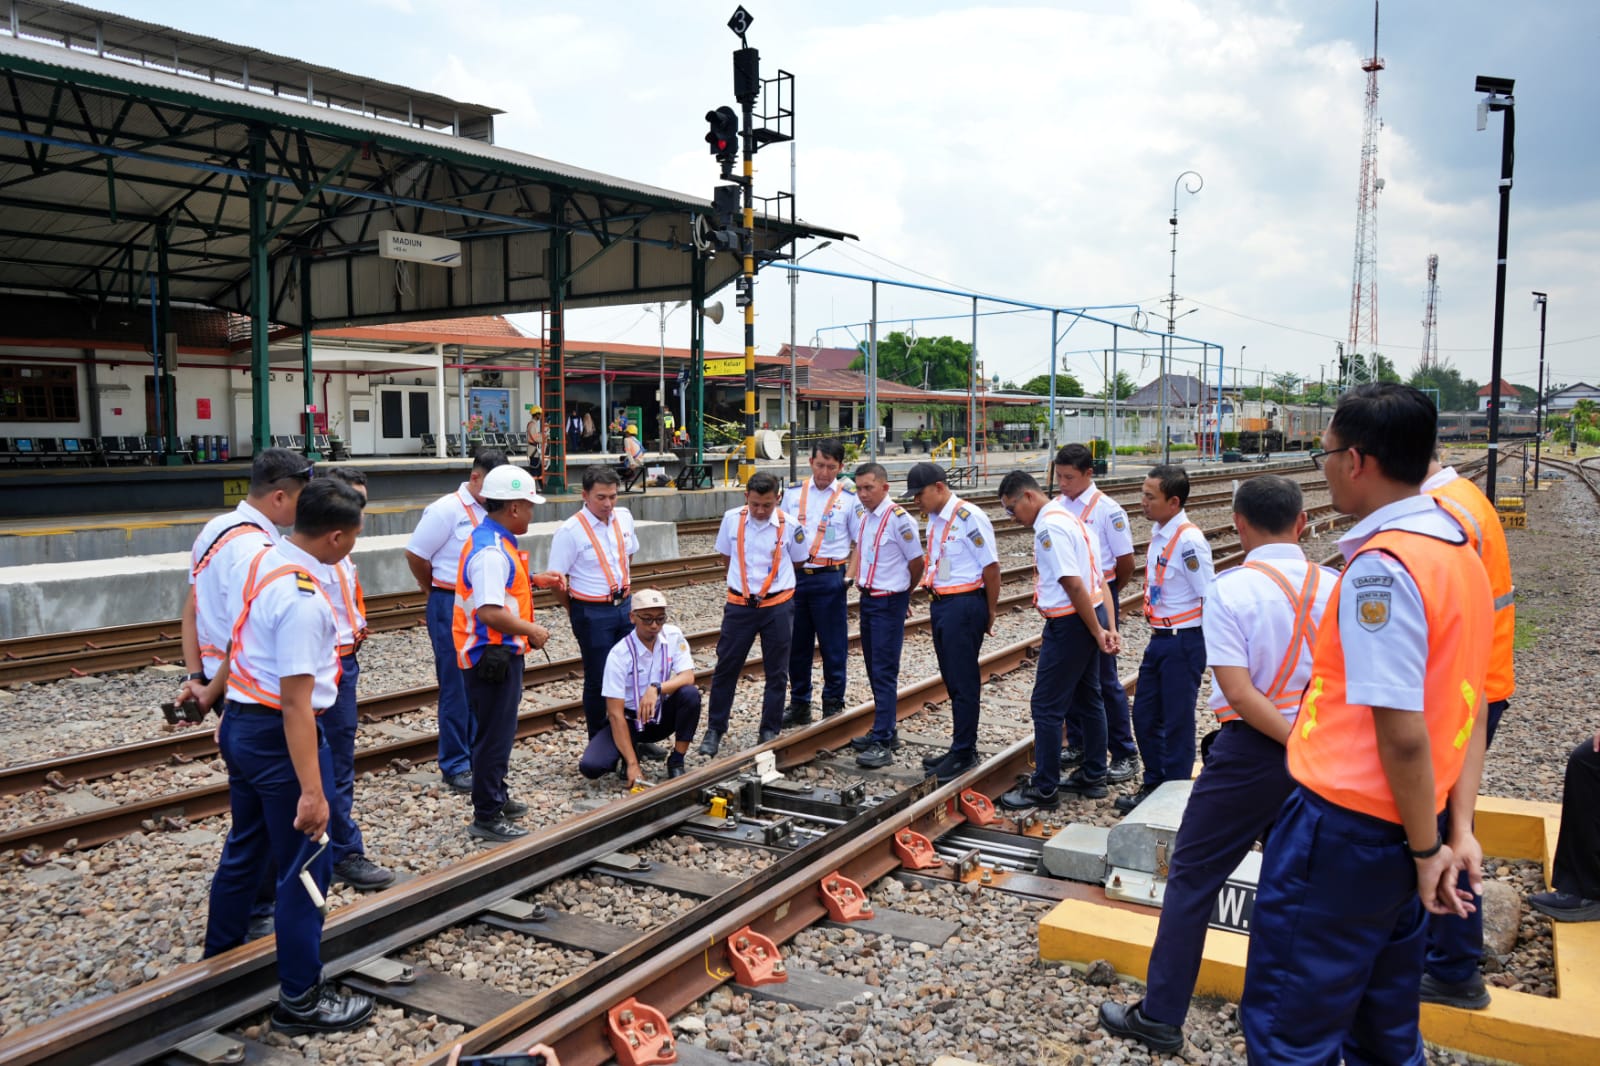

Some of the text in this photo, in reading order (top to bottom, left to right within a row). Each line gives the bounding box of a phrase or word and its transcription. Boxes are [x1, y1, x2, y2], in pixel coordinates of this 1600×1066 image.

[735, 10, 746, 33] 3
[392, 236, 422, 248] MADIUN
[1510, 516, 1525, 527] 112
